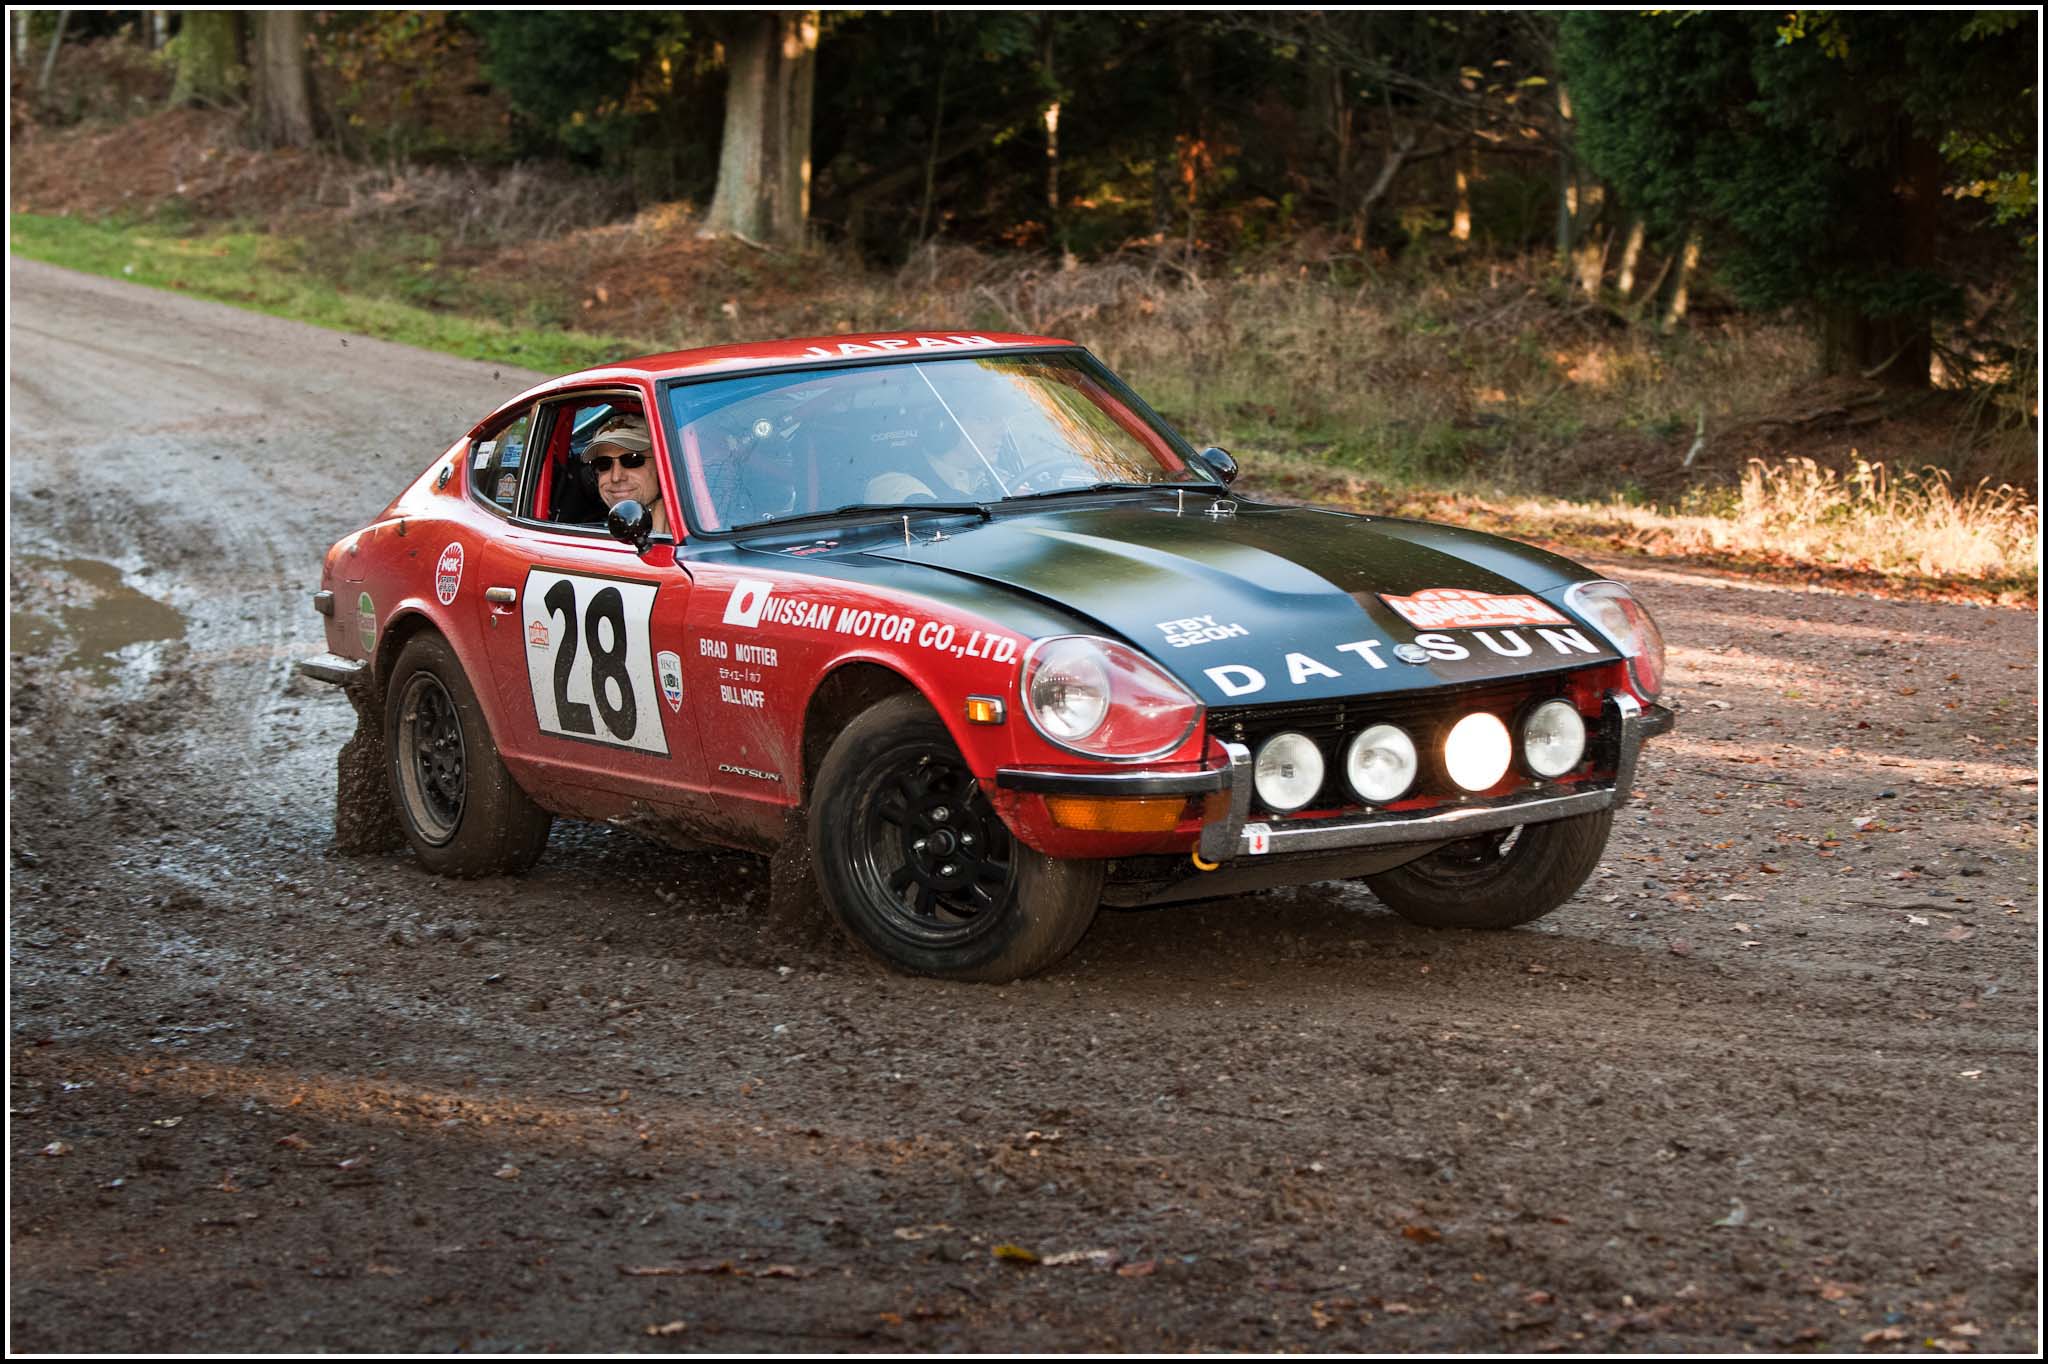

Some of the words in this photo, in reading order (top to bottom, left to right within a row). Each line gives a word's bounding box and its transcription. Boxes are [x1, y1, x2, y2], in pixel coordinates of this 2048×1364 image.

[802, 335, 998, 359] JAPAN
[441, 558, 459, 572] NGK
[760, 597, 836, 631] NISSAN
[836, 608, 916, 644] MOTOR
[1156, 615, 1217, 635] FBY
[1164, 623, 1250, 648] 520H
[544, 579, 637, 741] 28
[700, 638, 728, 659] BRAD
[735, 643, 778, 668] MOTTIER
[1203, 628, 1601, 697] DATSUN
[720, 685, 741, 705] BILL
[740, 688, 765, 709] HOFF
[718, 764, 779, 781] DATSUN
